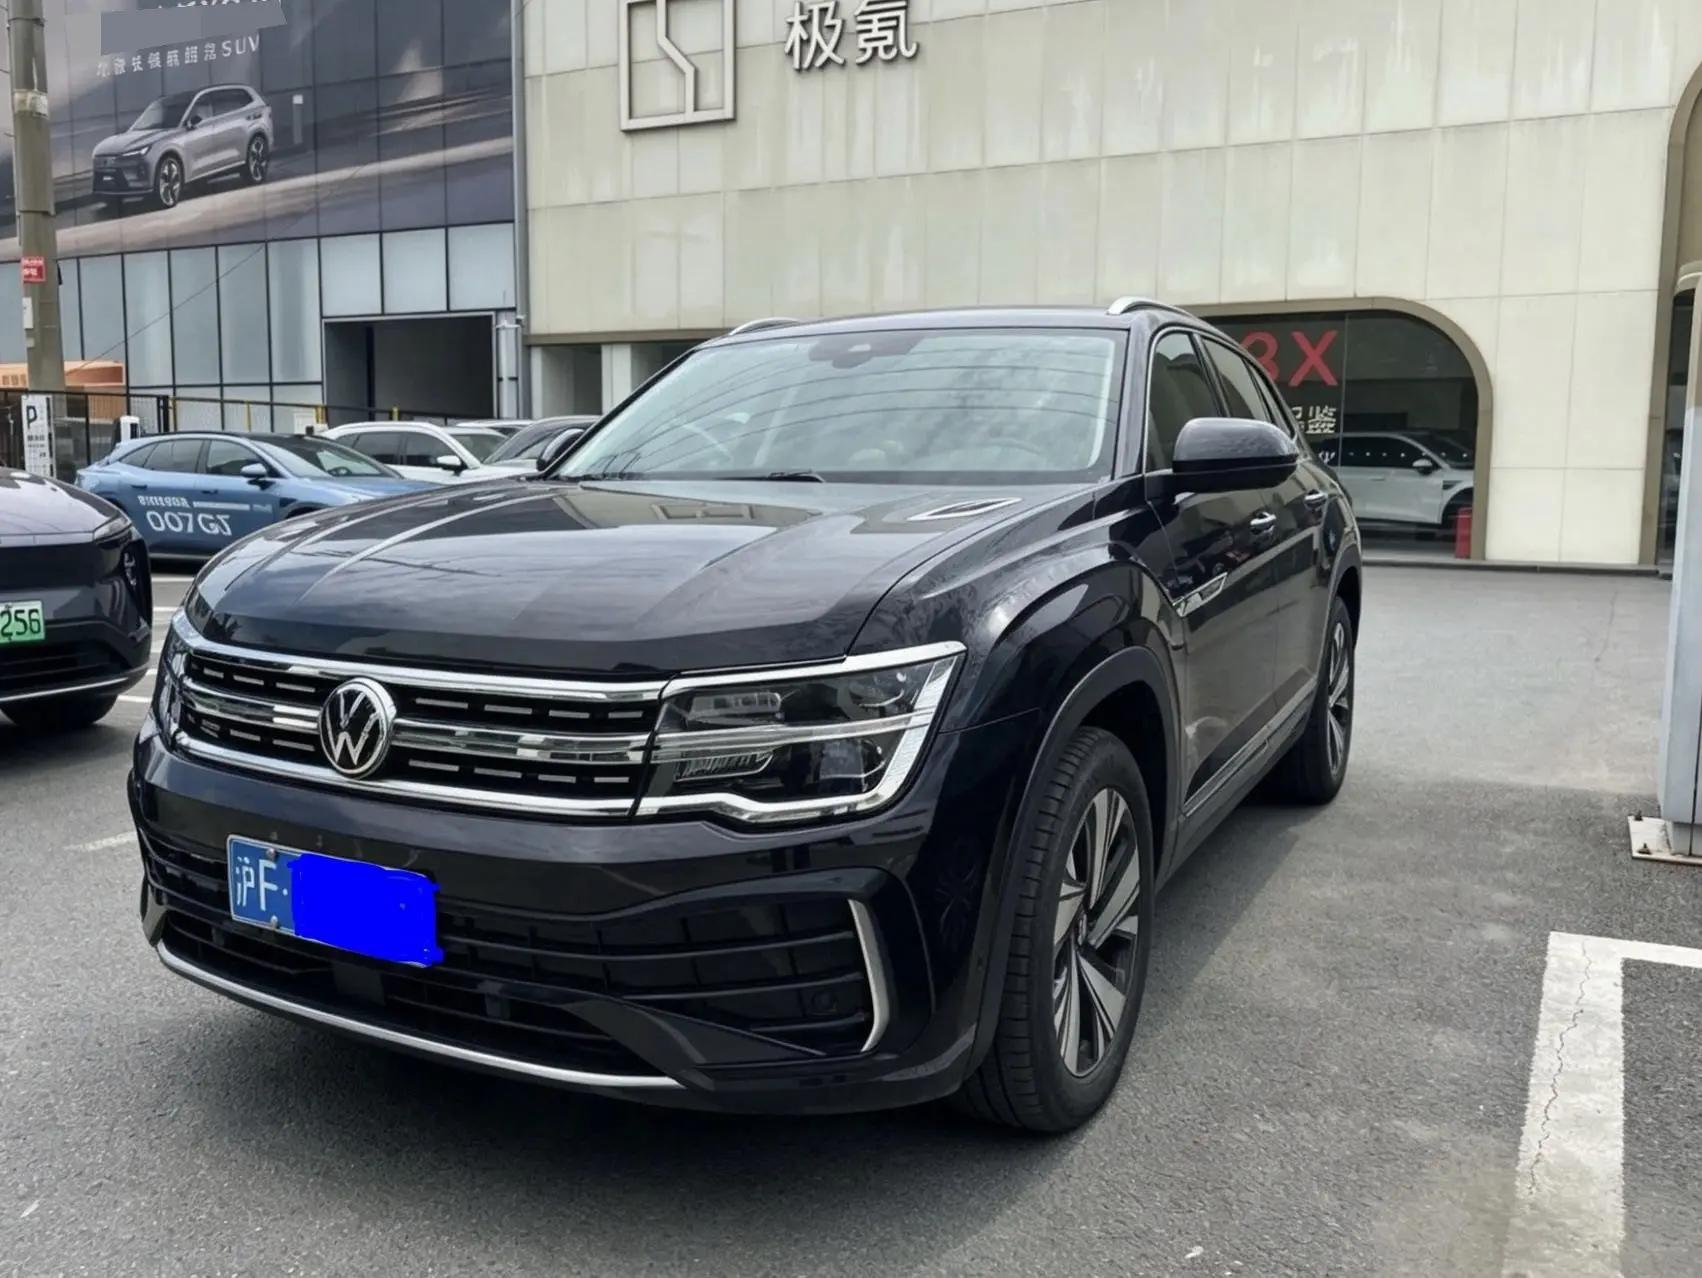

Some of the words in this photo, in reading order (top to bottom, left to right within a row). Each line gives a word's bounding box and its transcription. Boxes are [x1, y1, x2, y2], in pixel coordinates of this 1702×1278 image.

[221, 34, 260, 58] SUV
[784, 0, 918, 70] 极氪
[26, 405, 38, 430] P
